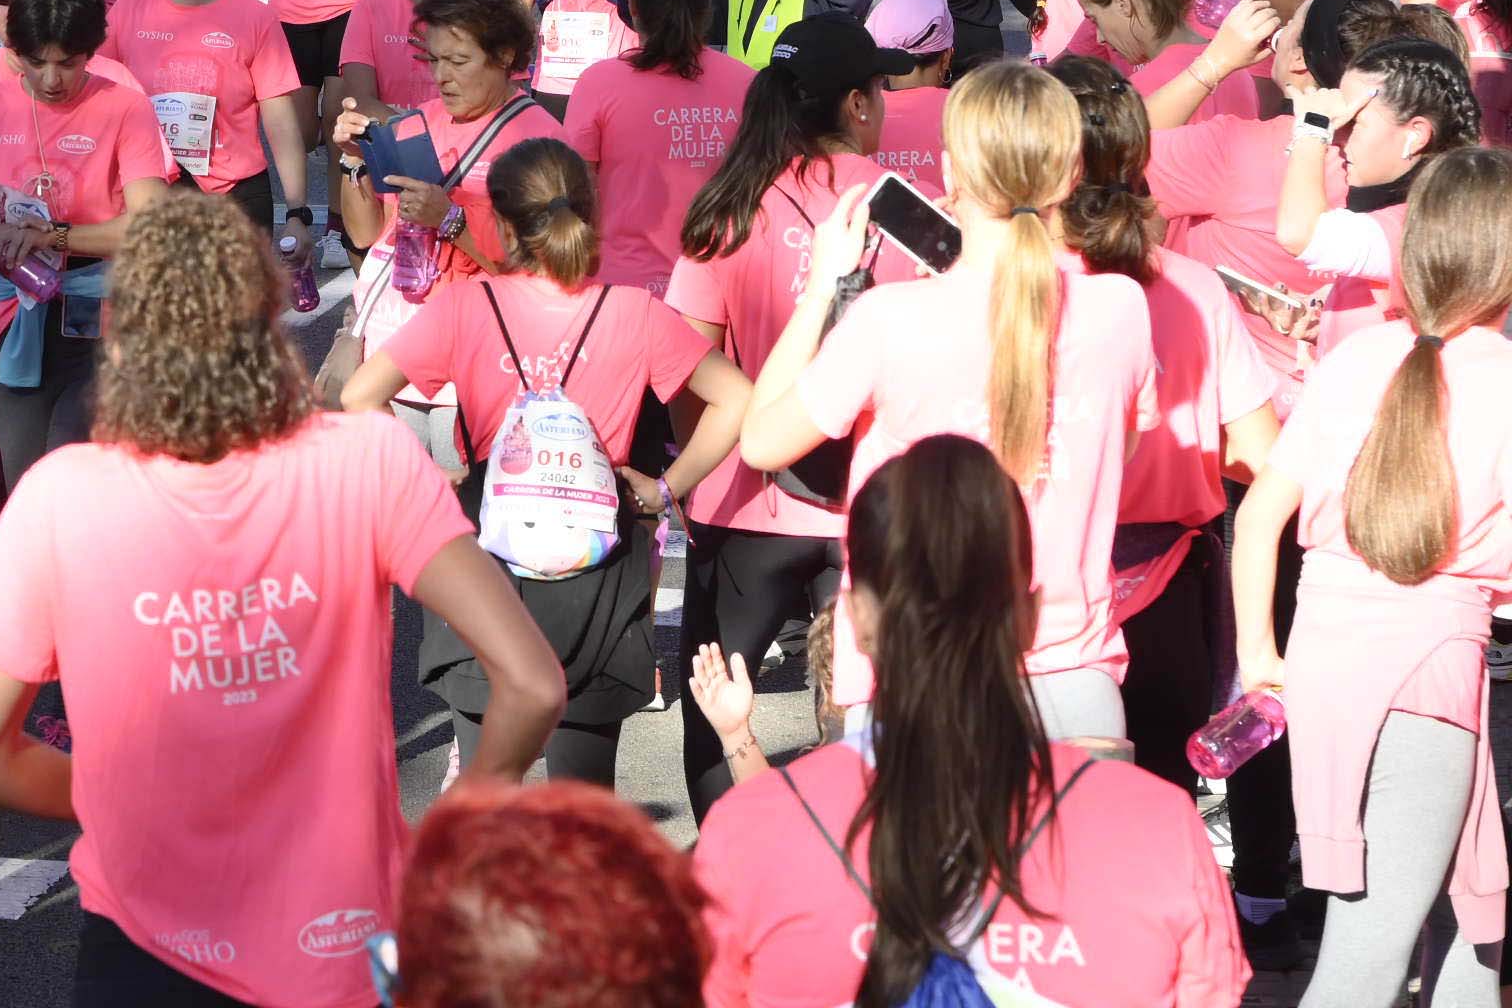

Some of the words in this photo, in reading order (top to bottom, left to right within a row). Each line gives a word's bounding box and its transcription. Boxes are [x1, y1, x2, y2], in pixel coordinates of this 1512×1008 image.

[137, 30, 174, 42] OYSHO
[653, 107, 738, 126] CARRERA
[671, 125, 694, 141] DE
[699, 124, 724, 141] LA
[668, 141, 727, 160] MUJER
[537, 449, 583, 470] 016
[540, 472, 576, 485] 24042
[503, 485, 538, 495] CARRERA
[542, 488, 553, 497] DE
[555, 489, 567, 498] LA
[568, 490, 593, 501] MUJER
[134, 572, 318, 626] CARRERA
[172, 622, 222, 657] DE
[237, 614, 288, 653] LA
[169, 647, 302, 694] MUJER
[222, 690, 258, 707] 2023
[173, 940, 237, 964] SHO
[849, 922, 1087, 967] CERA
